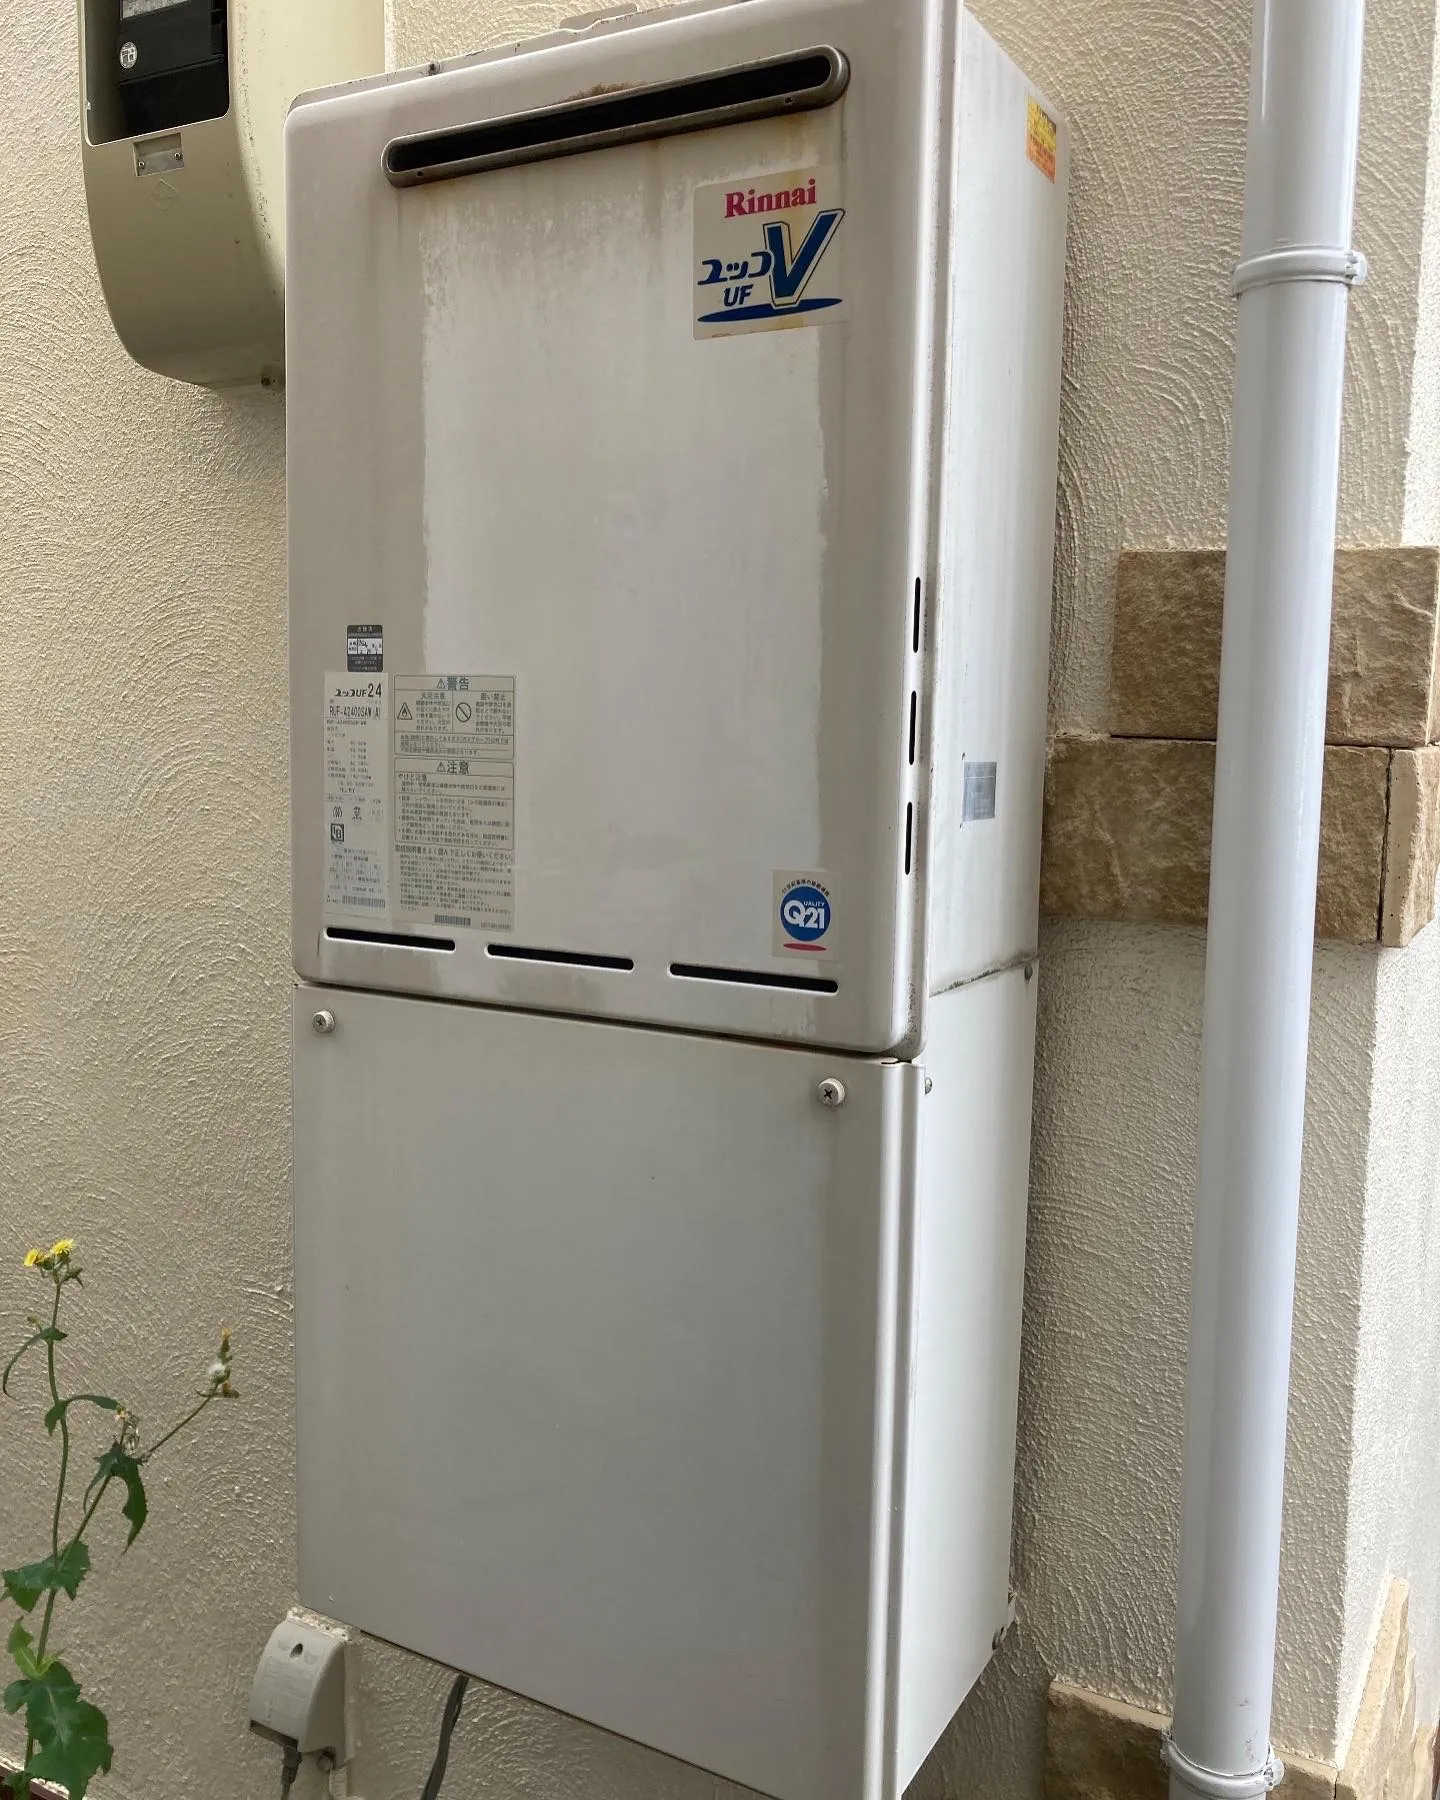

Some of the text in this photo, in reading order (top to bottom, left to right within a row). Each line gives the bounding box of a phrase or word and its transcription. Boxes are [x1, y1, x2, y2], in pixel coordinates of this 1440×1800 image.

[724, 178, 817, 218] Rinnai
[723, 284, 754, 307] UF
[447, 677, 470, 691] 警告
[446, 761, 470, 775] 注意
[783, 900, 825, 929] Q21
